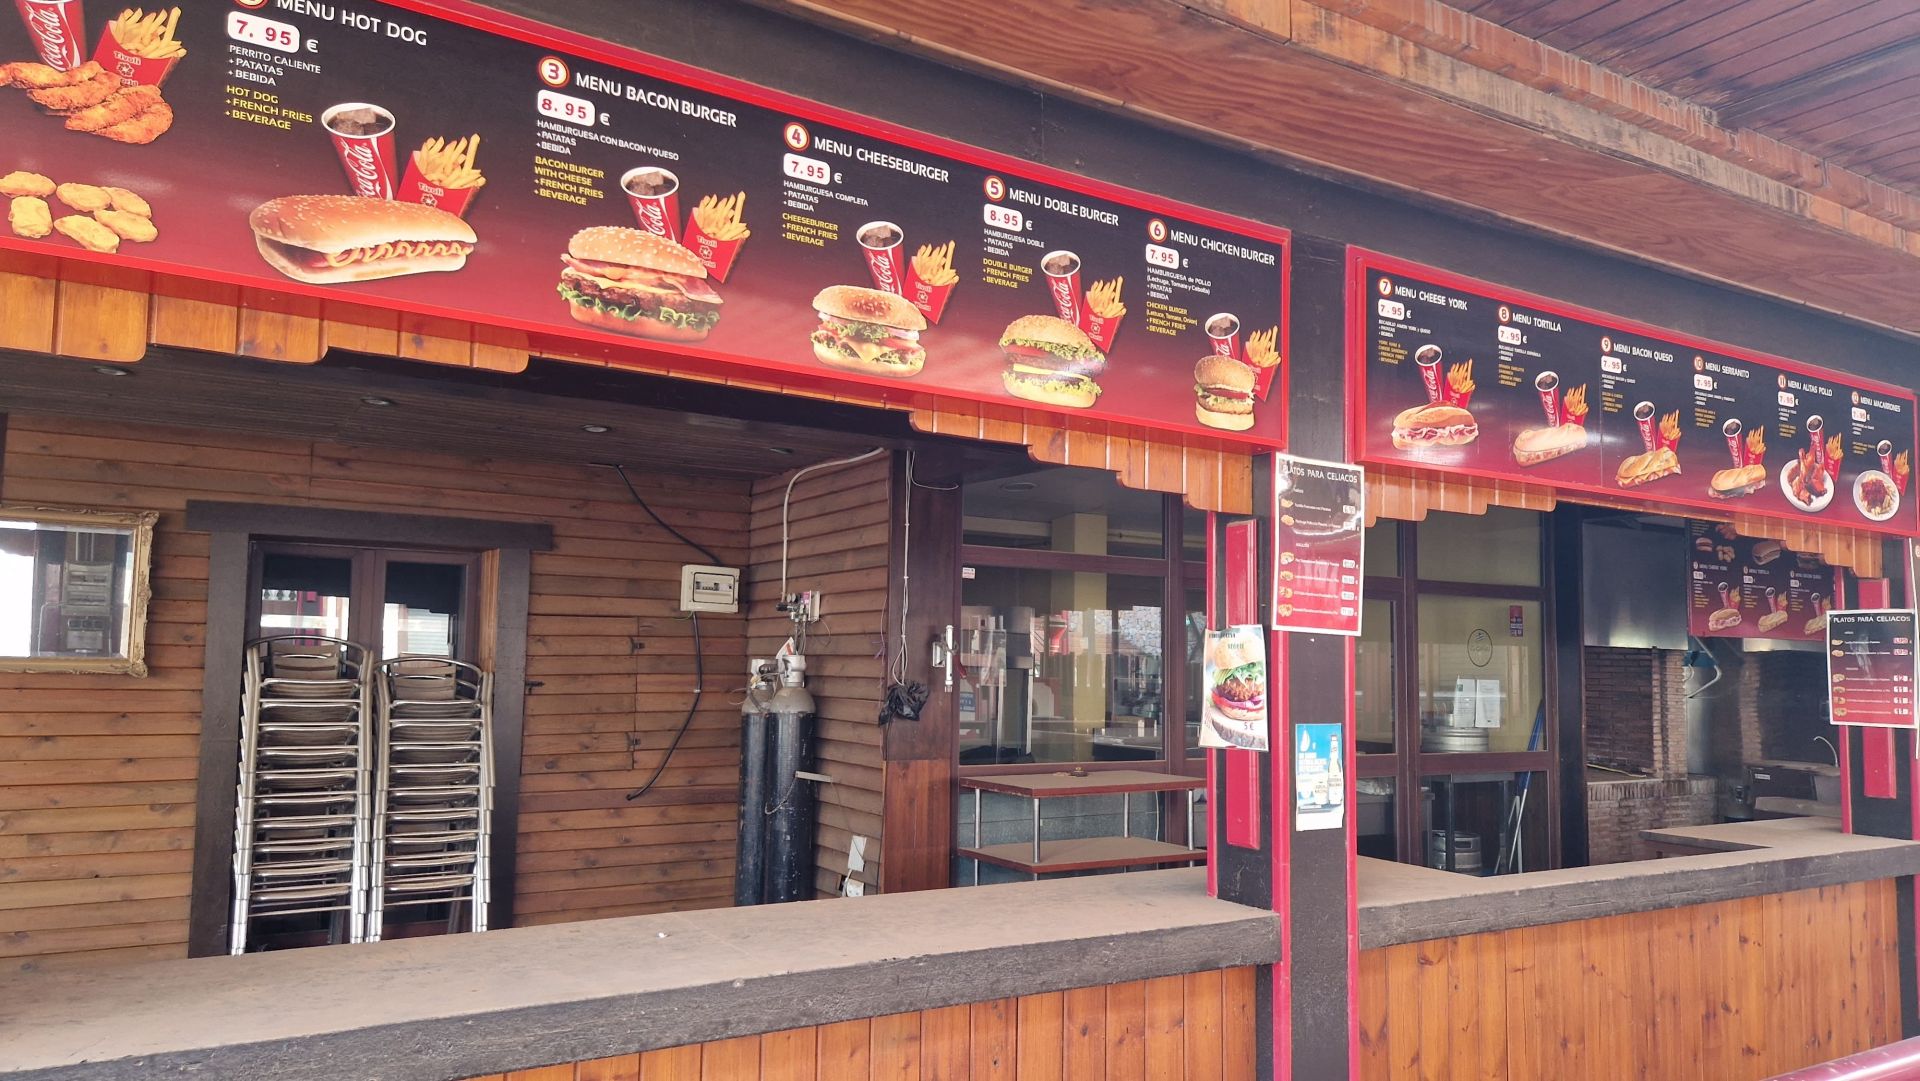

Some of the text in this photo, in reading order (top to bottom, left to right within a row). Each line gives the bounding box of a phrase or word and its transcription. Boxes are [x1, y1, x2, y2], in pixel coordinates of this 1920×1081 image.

[236, 19, 319, 53] 7.95 €
[342, 9, 381, 33] HOT
[387, 21, 428, 46] DOG
[229, 45, 322, 74] PERRITO CALIENTE
[226, 84, 279, 104] HOT DOG
[547, 62, 737, 128] 3 MENU BACON BURGER
[282, 108, 313, 124] FRIES
[541, 98, 611, 126] 8.95 €
[537, 119, 599, 142] HAMBURGUESA
[600, 134, 618, 147] CON
[618, 139, 648, 155] BACON
[653, 147, 679, 161] QUESO
[791, 128, 949, 183] 4 MENU CHEESEBURGER
[534, 166, 593, 187] WITH CHEESE
[535, 156, 605, 179] BACON BURGER
[791, 160, 843, 184] 7.95 €
[579, 187, 604, 199] FRIES
[783, 180, 869, 207] HAMBURGUESA COMPLETA
[989, 180, 1119, 226] 5 MENU DOBLE BURGER
[782, 213, 839, 231] CHEESEBURGER
[990, 210, 1018, 227] 8.95
[817, 230, 839, 240] FRIES
[984, 228, 1045, 249] HAMBURGUESA DOBLE
[1154, 223, 1275, 266] 6 MENU CHICKEN BURGER
[983, 258, 1033, 275] DOUBLE BURGER
[1150, 249, 1174, 264] 7.95
[1012, 273, 1030, 283] FRIES
[1382, 281, 1468, 311] 7 MENU CHEESE YORK
[1512, 312, 1532, 325] MENU
[1533, 317, 1562, 332] TORTILLA
[1613, 342, 1631, 354] MENU
[1632, 346, 1652, 359] BACON
[1653, 351, 1674, 363] QUESO
[1705, 361, 1721, 373] MENU
[1307, 469, 1325, 479] PARA
[1326, 471, 1358, 484] CELIACOS
